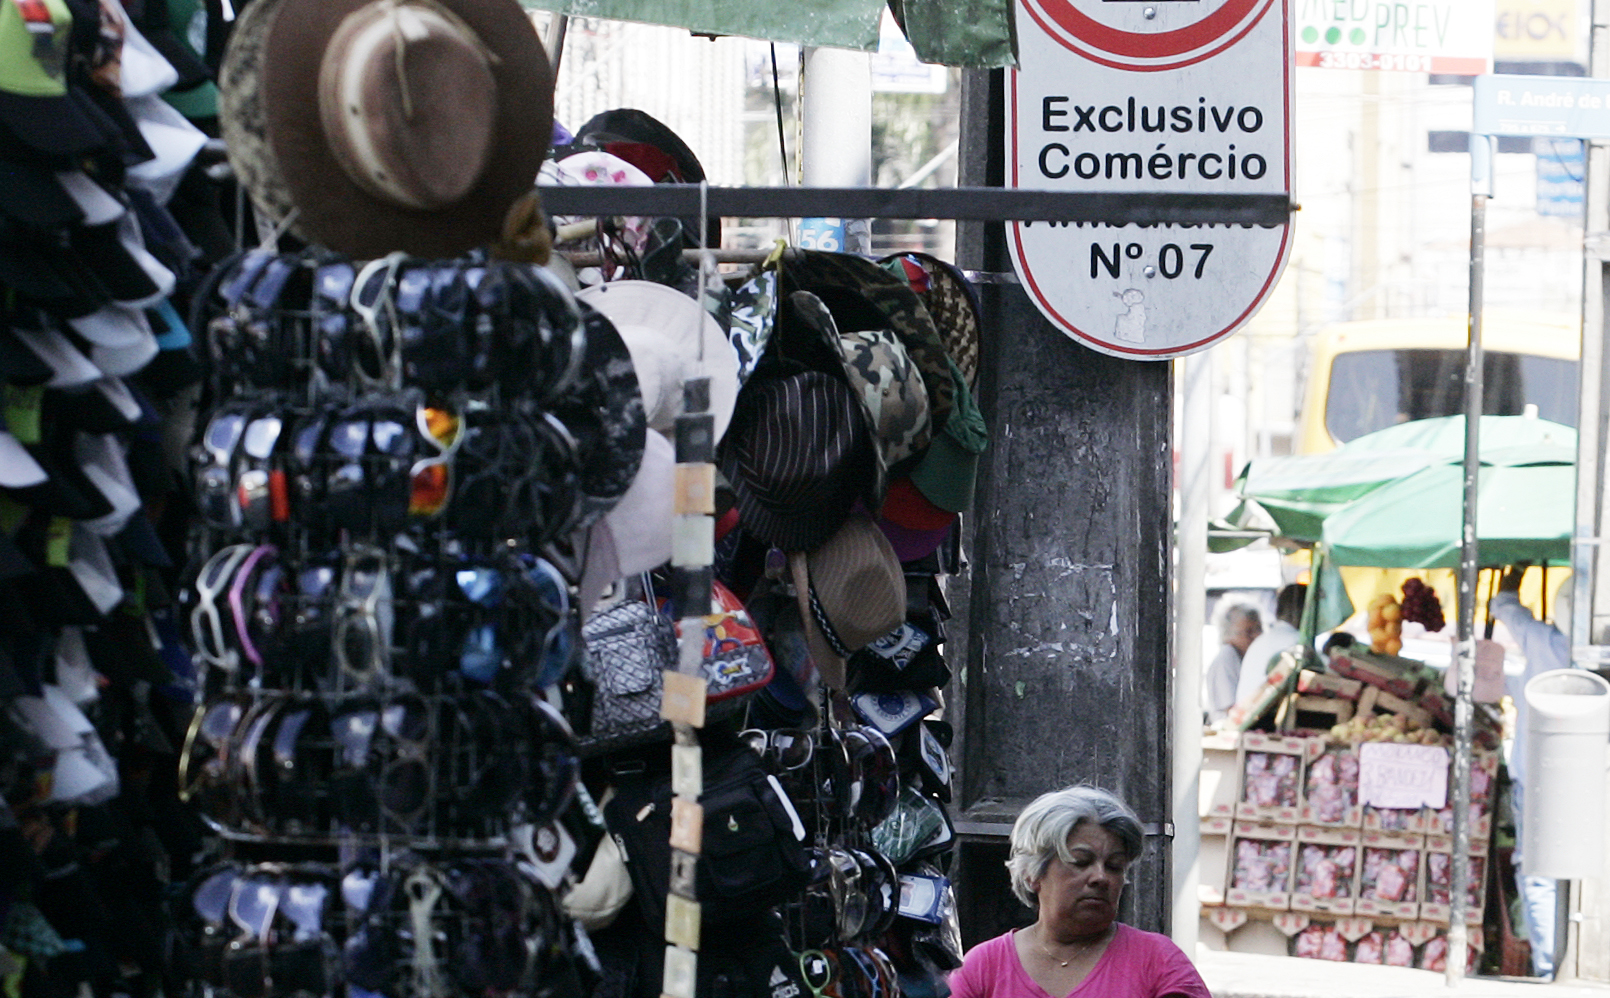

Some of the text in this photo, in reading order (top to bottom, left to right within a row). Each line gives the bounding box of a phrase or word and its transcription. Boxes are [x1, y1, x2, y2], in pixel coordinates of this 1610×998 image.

[1374, 3, 1451, 48] PREV
[1319, 51, 1432, 71] 3303-0101
[1041, 95, 1264, 133] Exclusivo
[1497, 89, 1516, 107] R.
[1520, 91, 1574, 108] André
[1578, 93, 1602, 109] de
[1038, 142, 1268, 180] Comércio
[1090, 243, 1214, 280] Nº 07
